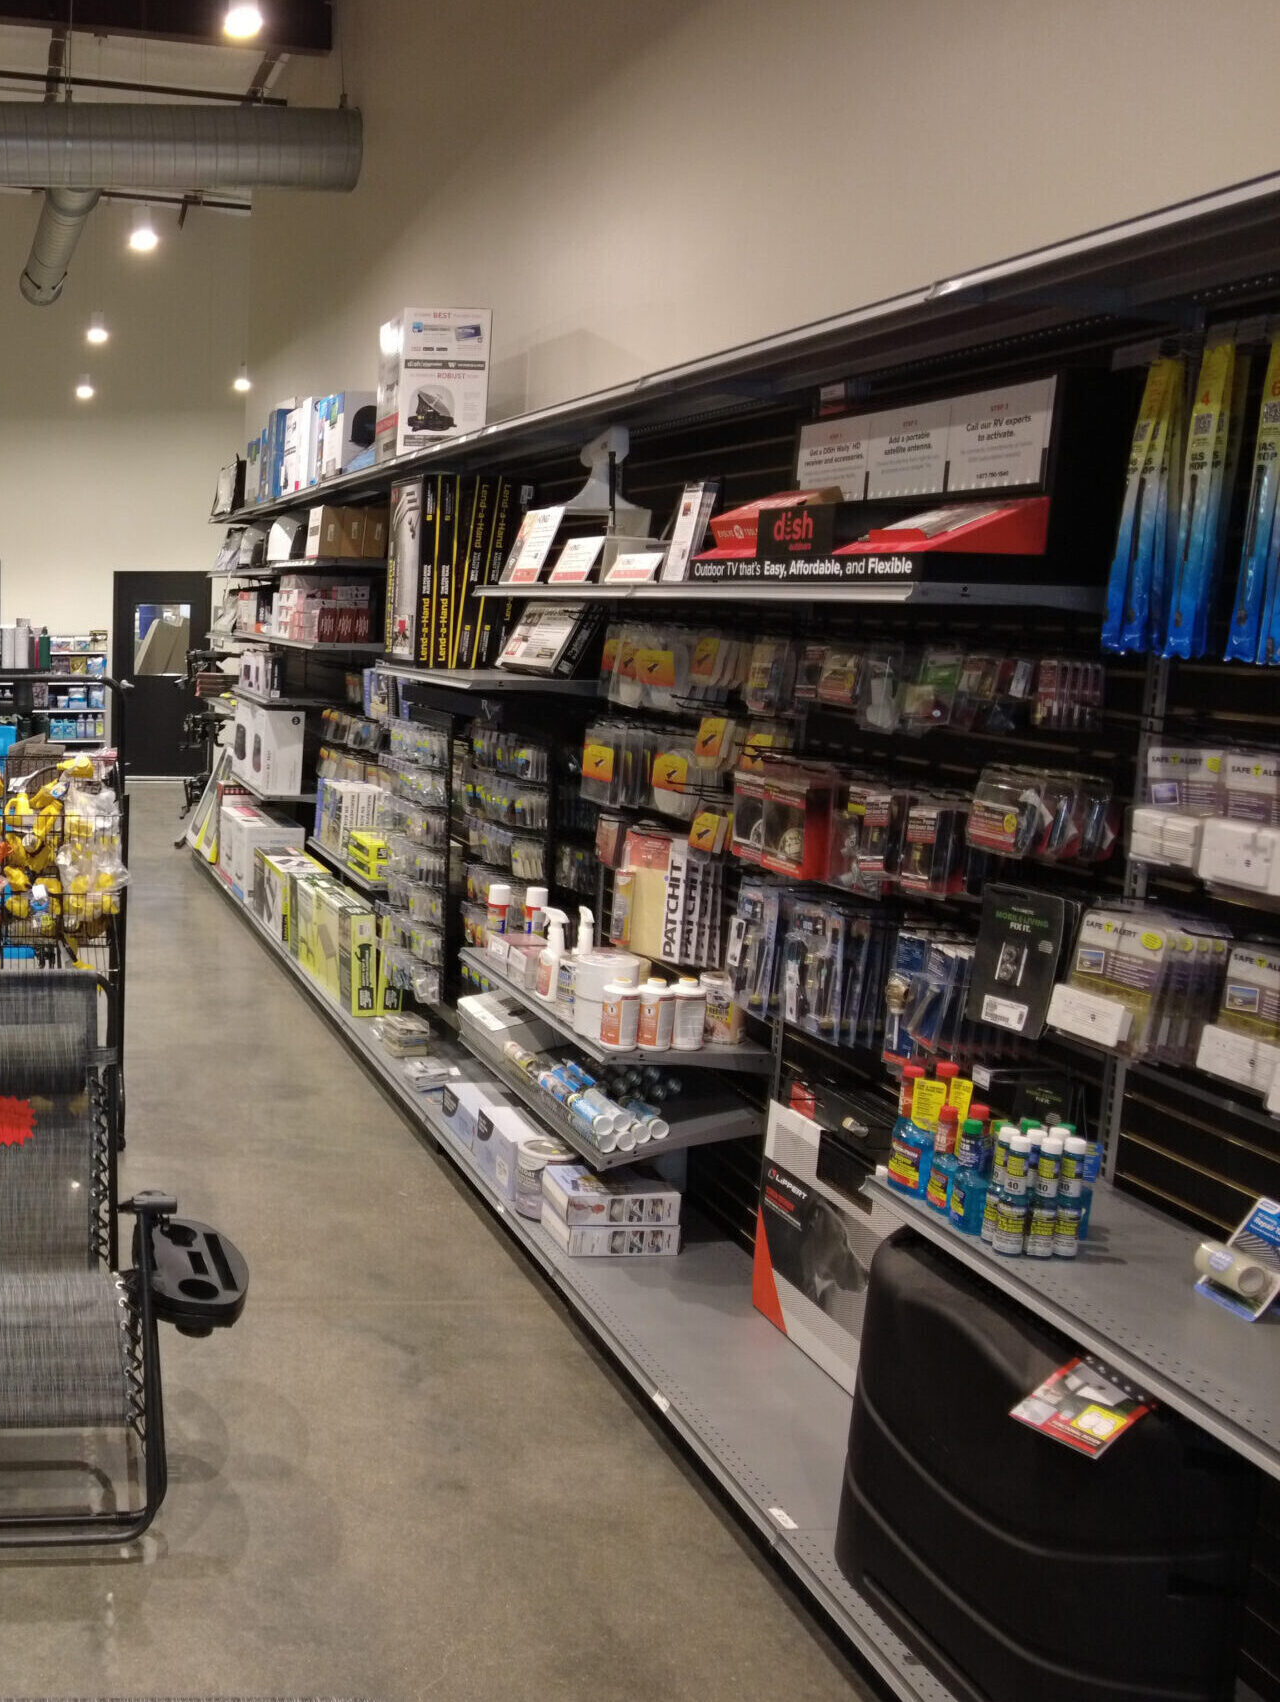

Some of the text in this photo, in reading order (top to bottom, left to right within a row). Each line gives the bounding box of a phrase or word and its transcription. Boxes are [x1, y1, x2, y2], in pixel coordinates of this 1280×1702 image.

[966, 422, 979, 432] Call
[1005, 415, 1032, 426] experts
[906, 431, 930, 442] portable
[986, 430, 1015, 441] activate.
[475, 484, 489, 549] Lend-a-Hand
[495, 484, 511, 549] Lend-a-Hand
[774, 510, 814, 541] dish
[694, 557, 913, 579] Outdoor TV that's Easy, Affordable, and Flexible
[420, 598, 430, 661] Lend-a-Hand
[438, 598, 449, 661] Lend-a-Hand
[1231, 765, 1250, 774] SAFE
[662, 859, 682, 958] PATCHIT
[1009, 921, 1021, 931] FIX
[1086, 919, 1104, 930] SAFE
[1113, 926, 1138, 938] ALERT
[1234, 953, 1255, 965] SAFE
[776, 1174, 808, 1199] LIPPERT
[1007, 1182, 1019, 1190] 40
